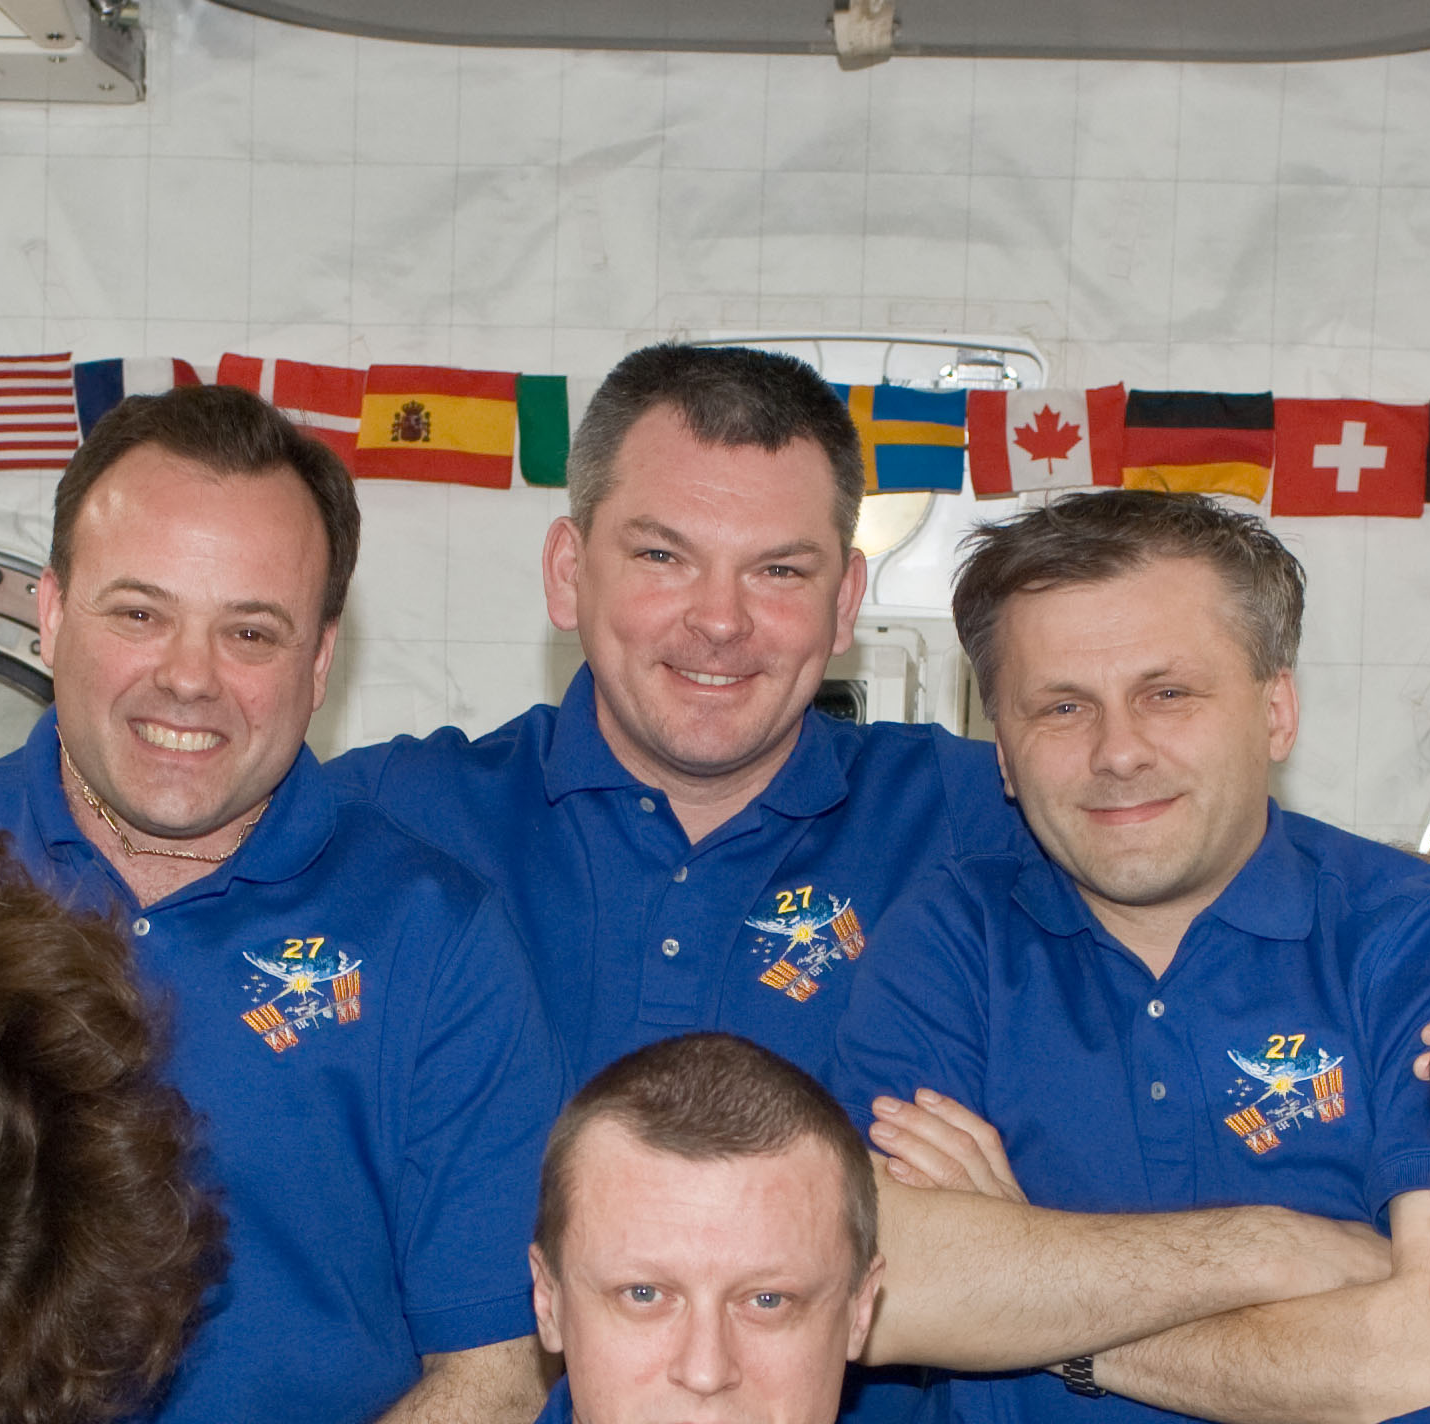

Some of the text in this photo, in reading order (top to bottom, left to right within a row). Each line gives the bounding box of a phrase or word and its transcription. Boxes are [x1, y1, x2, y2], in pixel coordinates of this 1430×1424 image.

[775, 885, 814, 915] 27
[283, 937, 325, 961] 27
[1265, 1034, 1306, 1061] 27
